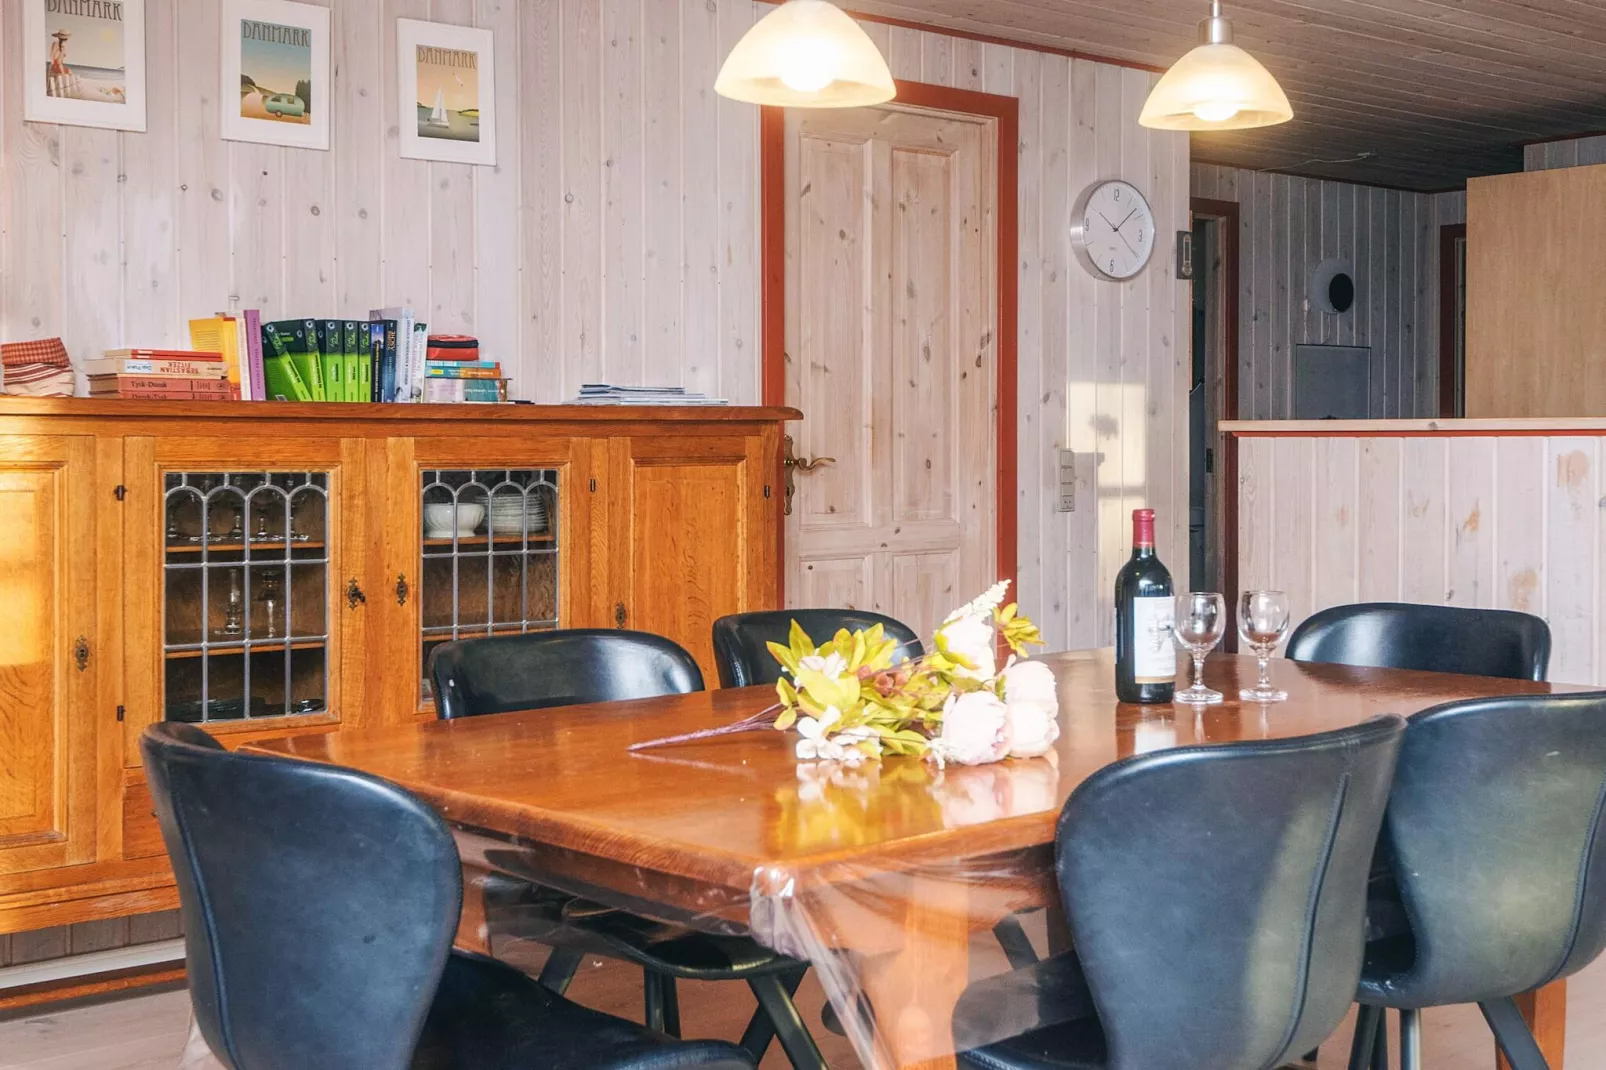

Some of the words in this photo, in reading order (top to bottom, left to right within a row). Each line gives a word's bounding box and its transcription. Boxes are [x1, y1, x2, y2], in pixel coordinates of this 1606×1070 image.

[46, 0, 122, 21] DANMARK
[243, 21, 310, 47] DANMARK
[417, 46, 477, 69] DANMARK
[1113, 188, 1121, 202] 12
[1084, 217, 1090, 231] 9
[1137, 229, 1143, 243] 3
[1109, 259, 1115, 273] 6
[160, 366, 199, 374] SEBASTIAN
